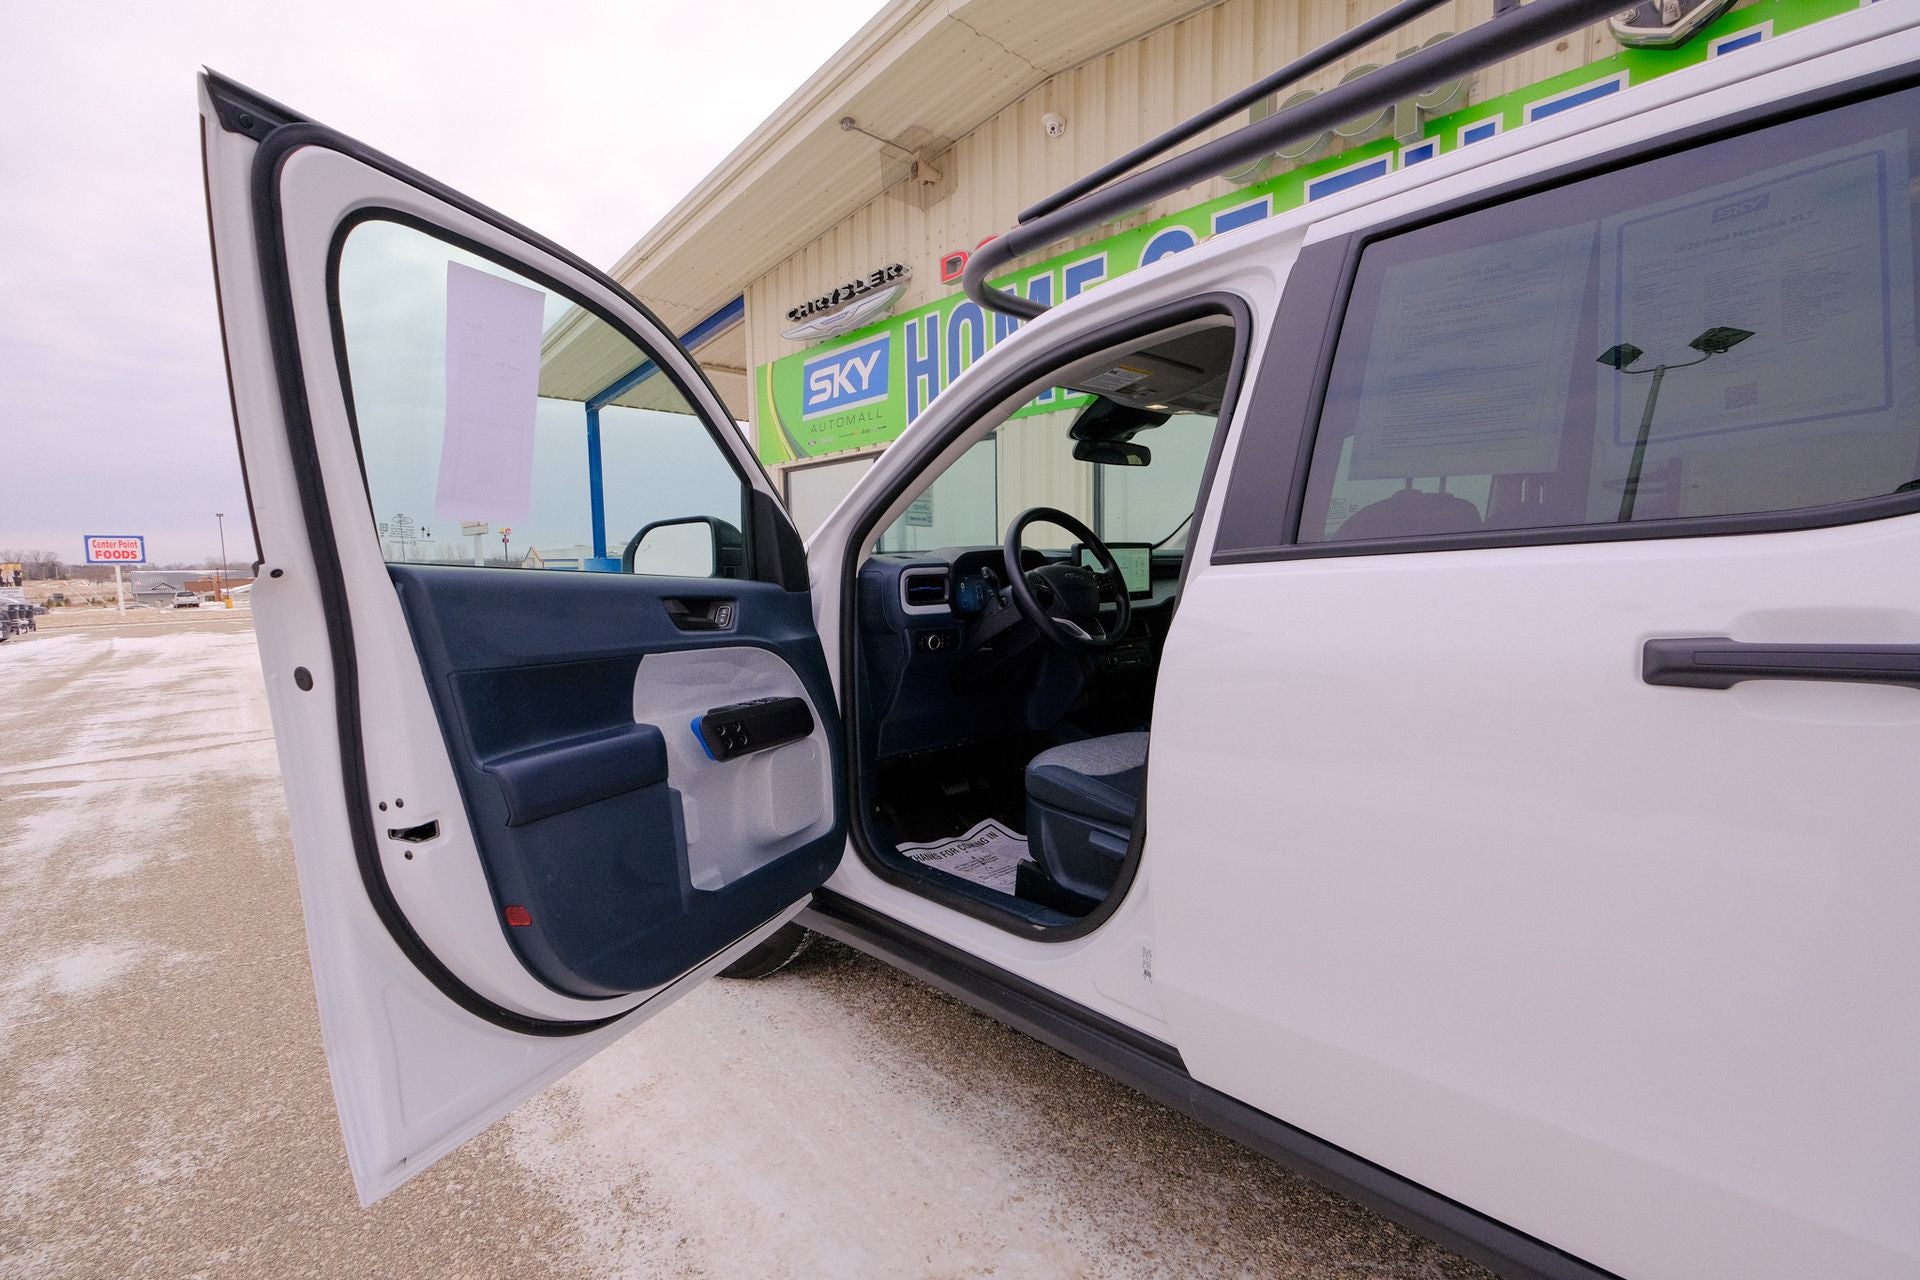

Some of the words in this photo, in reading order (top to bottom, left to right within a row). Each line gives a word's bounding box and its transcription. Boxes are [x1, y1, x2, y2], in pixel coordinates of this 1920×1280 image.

[786, 262, 912, 321] CHRYSLER
[808, 349, 882, 406] SKY
[811, 408, 883, 433] AUTOMALL
[92, 540, 117, 549] Center
[118, 540, 138, 549] Point
[95, 550, 138, 560] FOODS
[940, 848, 959, 858] FOR
[985, 831, 999, 840] IN
